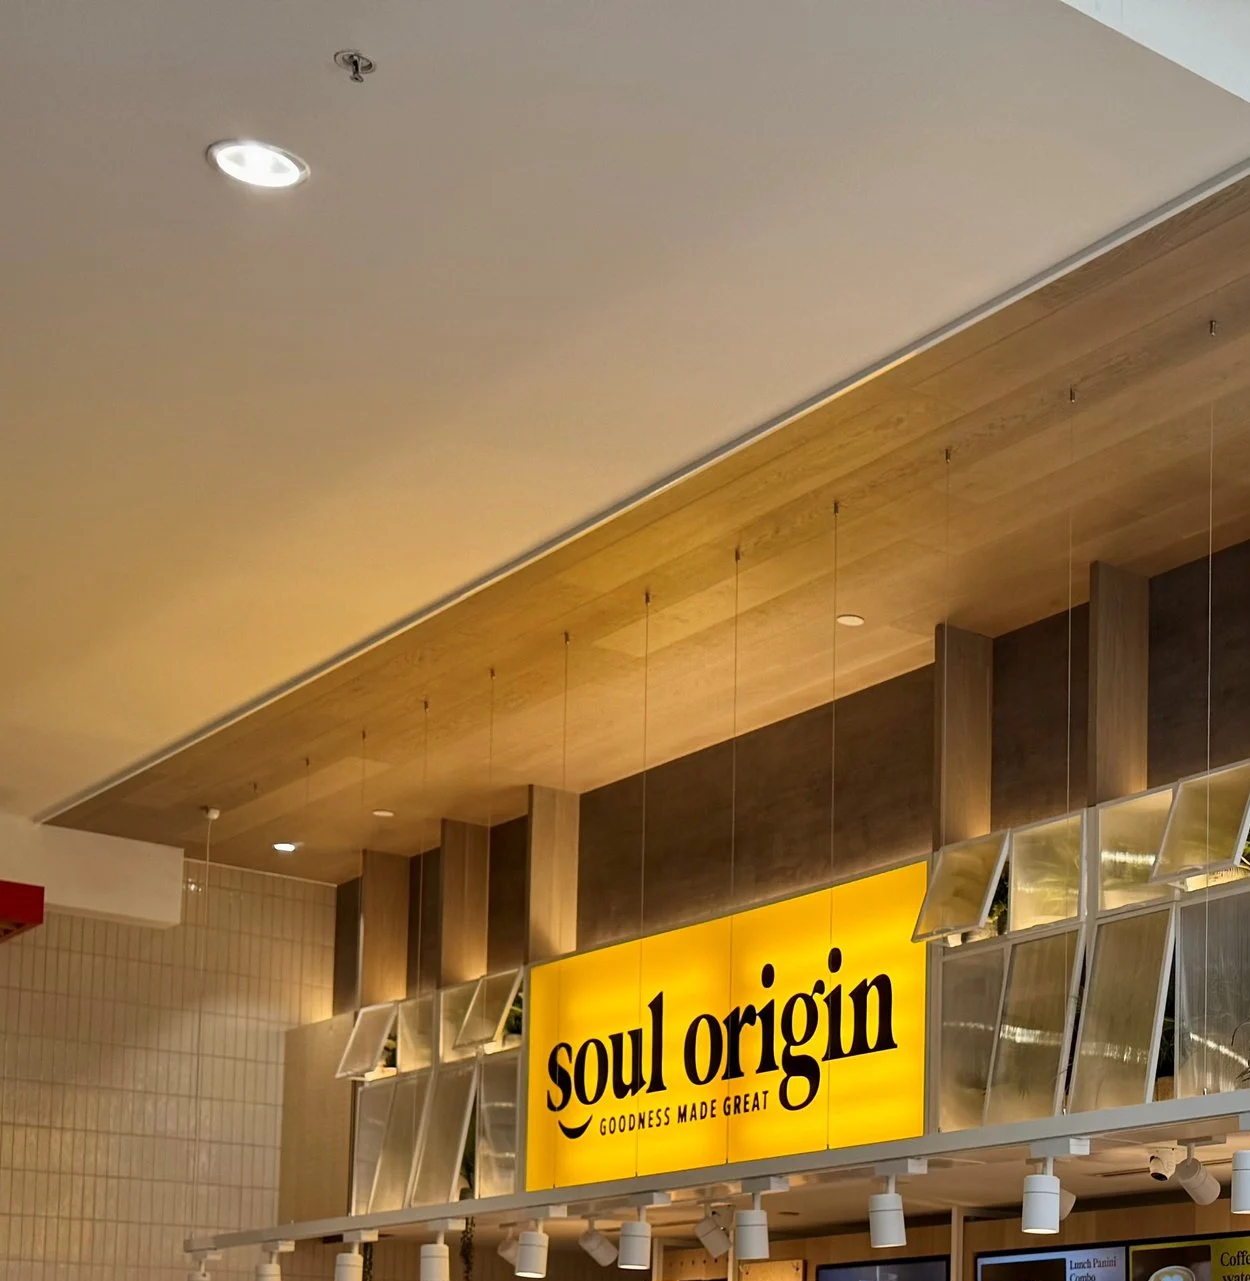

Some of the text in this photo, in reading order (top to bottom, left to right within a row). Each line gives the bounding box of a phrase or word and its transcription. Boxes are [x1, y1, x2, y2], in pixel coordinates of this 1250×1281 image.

[546, 947, 897, 1112] soul origin
[600, 1090, 769, 1136] GOODNESS MADE GREAT
[1070, 1259, 1092, 1270] Lunch
